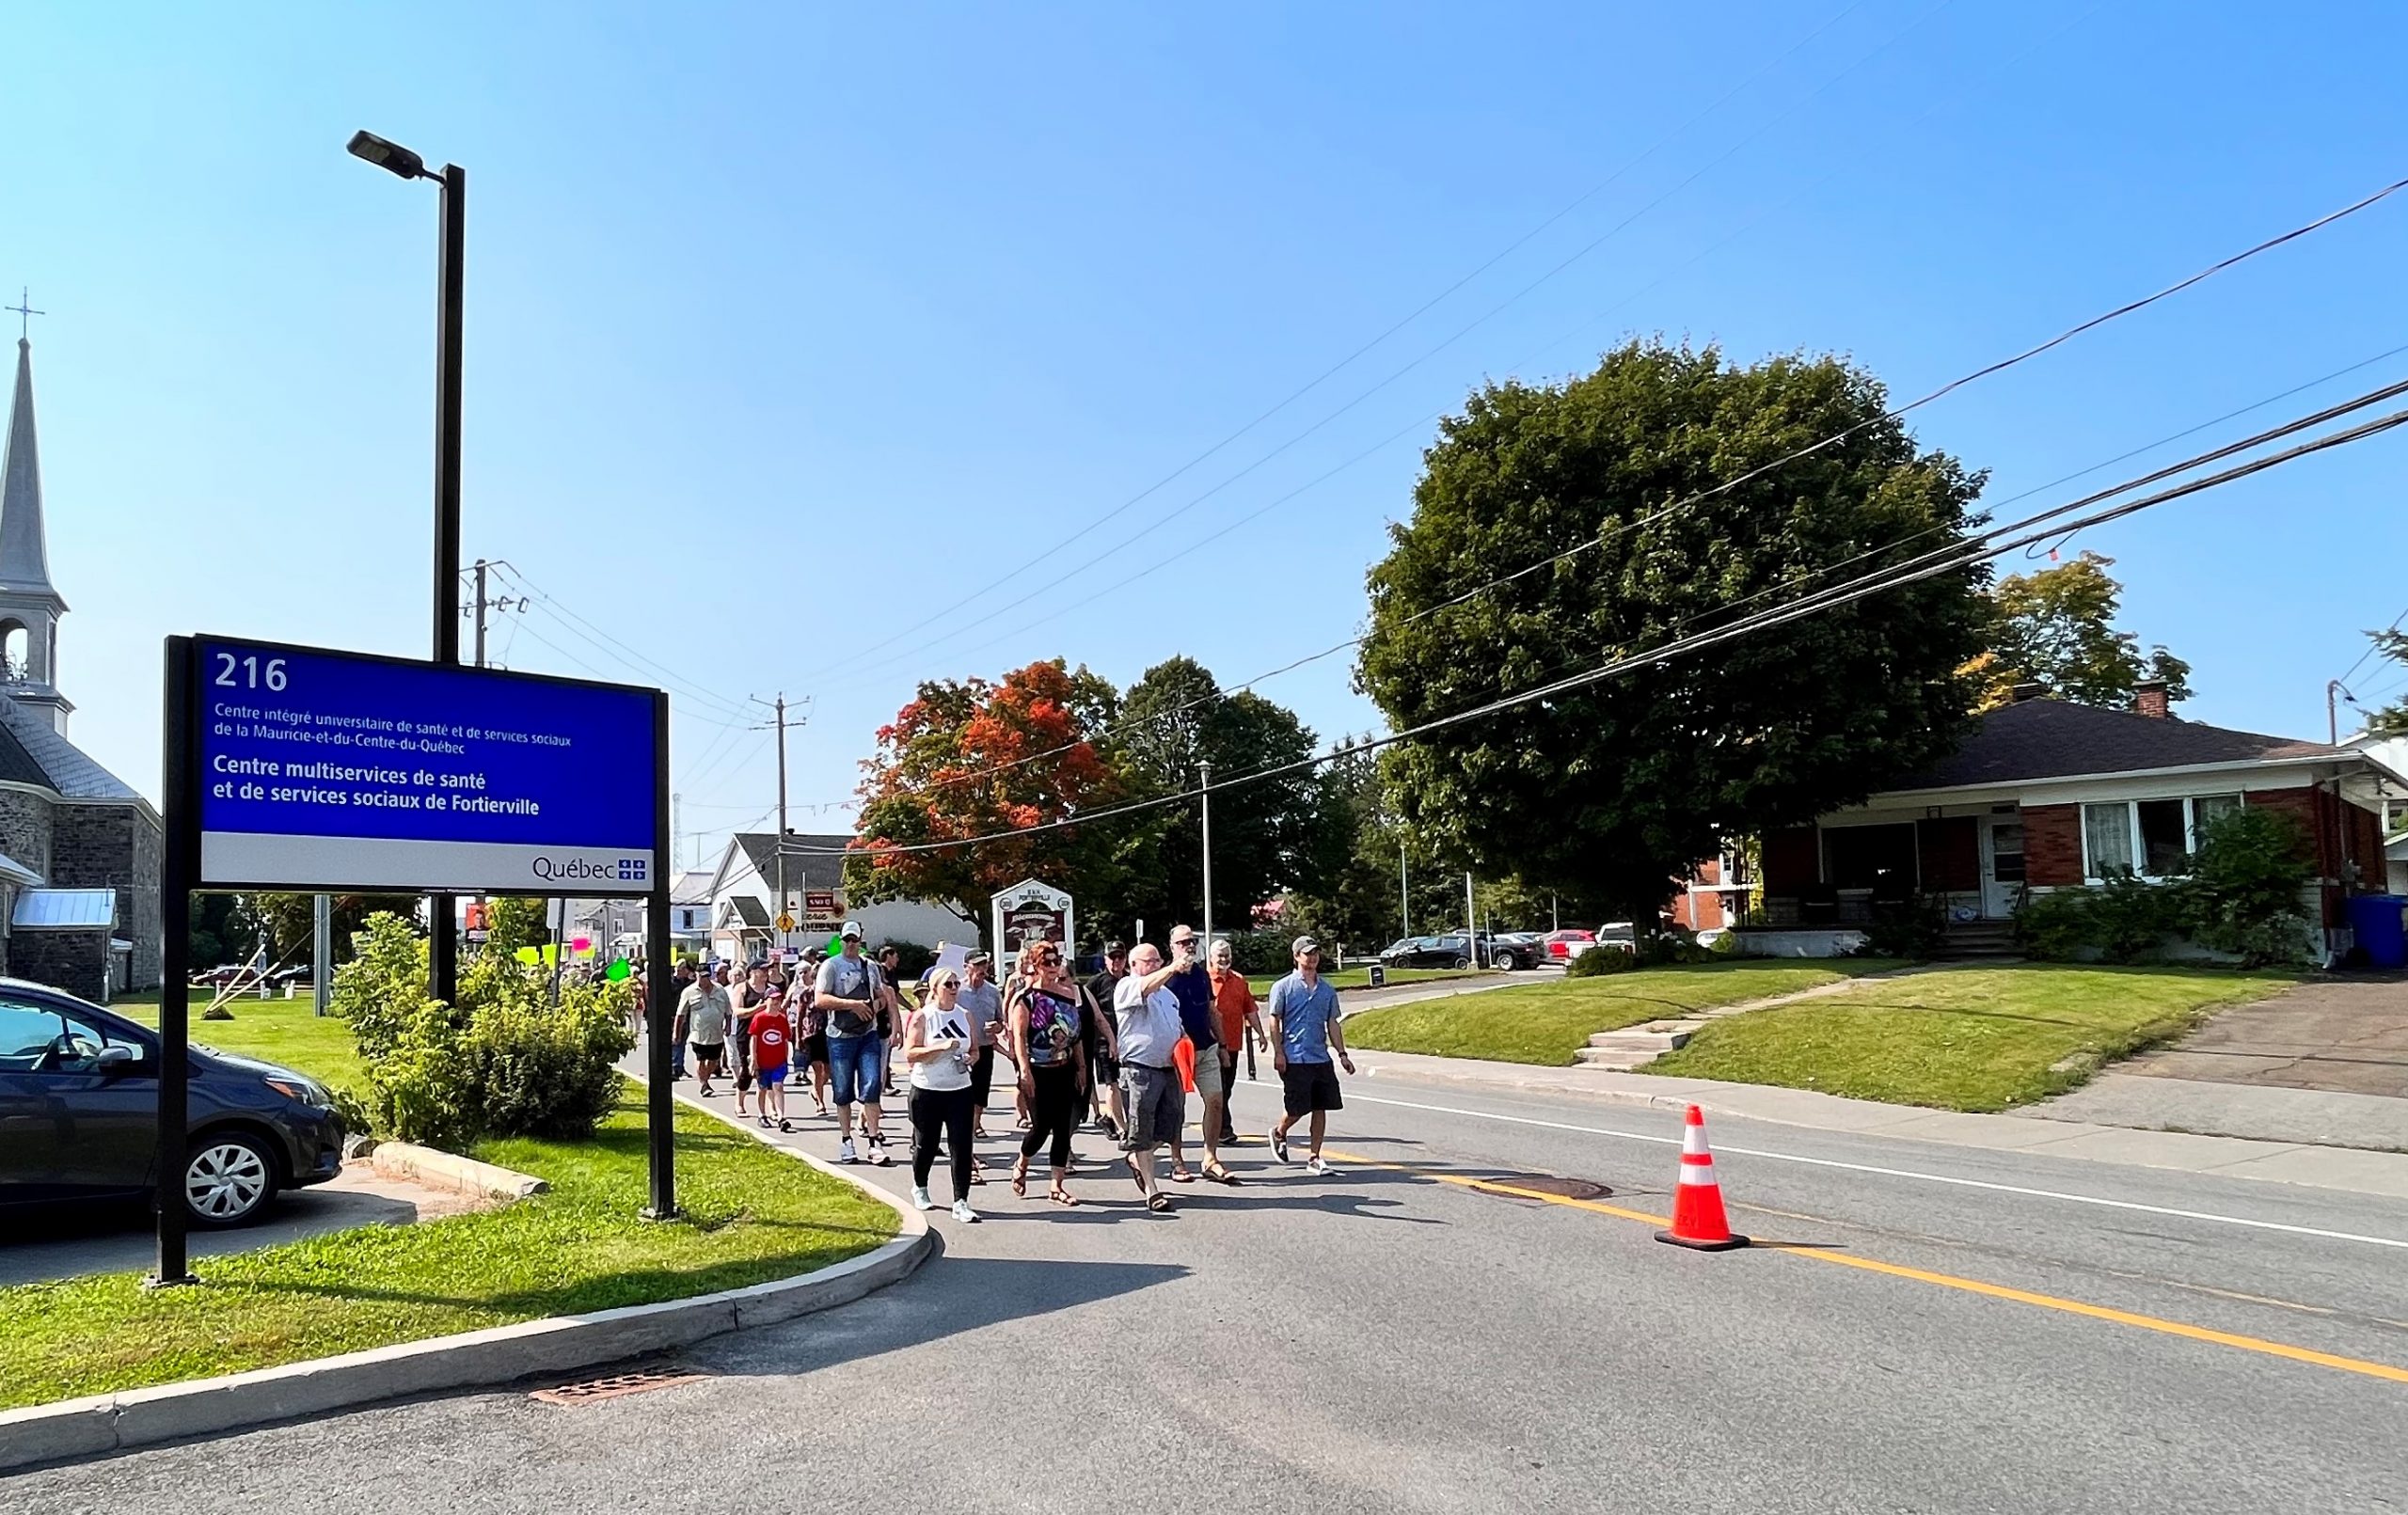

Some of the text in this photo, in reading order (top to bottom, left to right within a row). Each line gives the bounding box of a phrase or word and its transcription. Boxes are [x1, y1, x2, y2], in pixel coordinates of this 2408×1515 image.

[214, 653, 287, 691] 216
[214, 702, 571, 747] Centre intégré universitaire de santé et de services sociaux
[214, 722, 465, 754] de la Mauricie-et-du-Centre-du-Québec
[213, 754, 485, 790] Centre multiservices de santé
[213, 781, 539, 815] et de services sociaux de Fortierville
[532, 857, 615, 881] Québec
